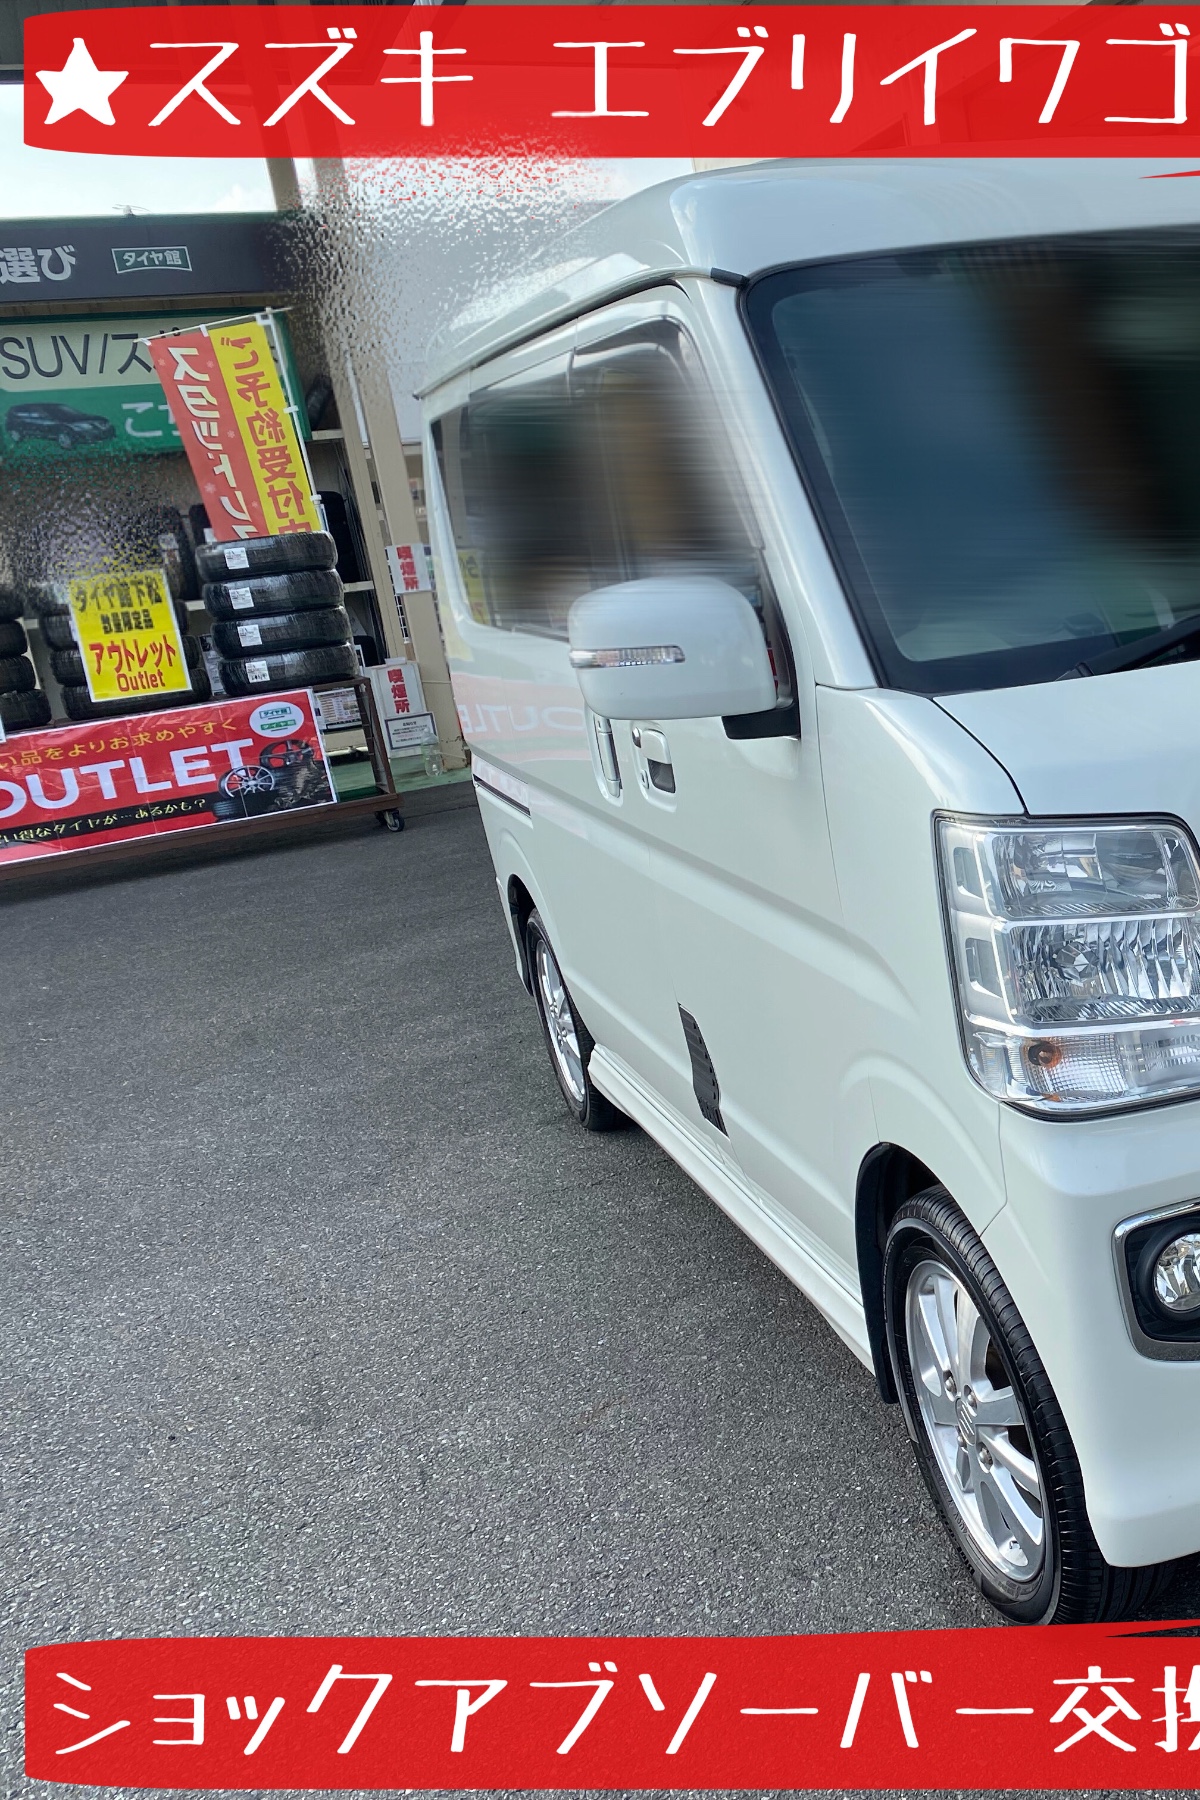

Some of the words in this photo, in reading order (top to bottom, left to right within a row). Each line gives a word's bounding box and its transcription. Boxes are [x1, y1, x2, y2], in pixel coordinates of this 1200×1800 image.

[123, 250, 183, 266] タイヤ館
[0, 327, 181, 379] SUV/ス
[88, 634, 176, 675] アウトレット
[116, 669, 166, 692] Outlet
